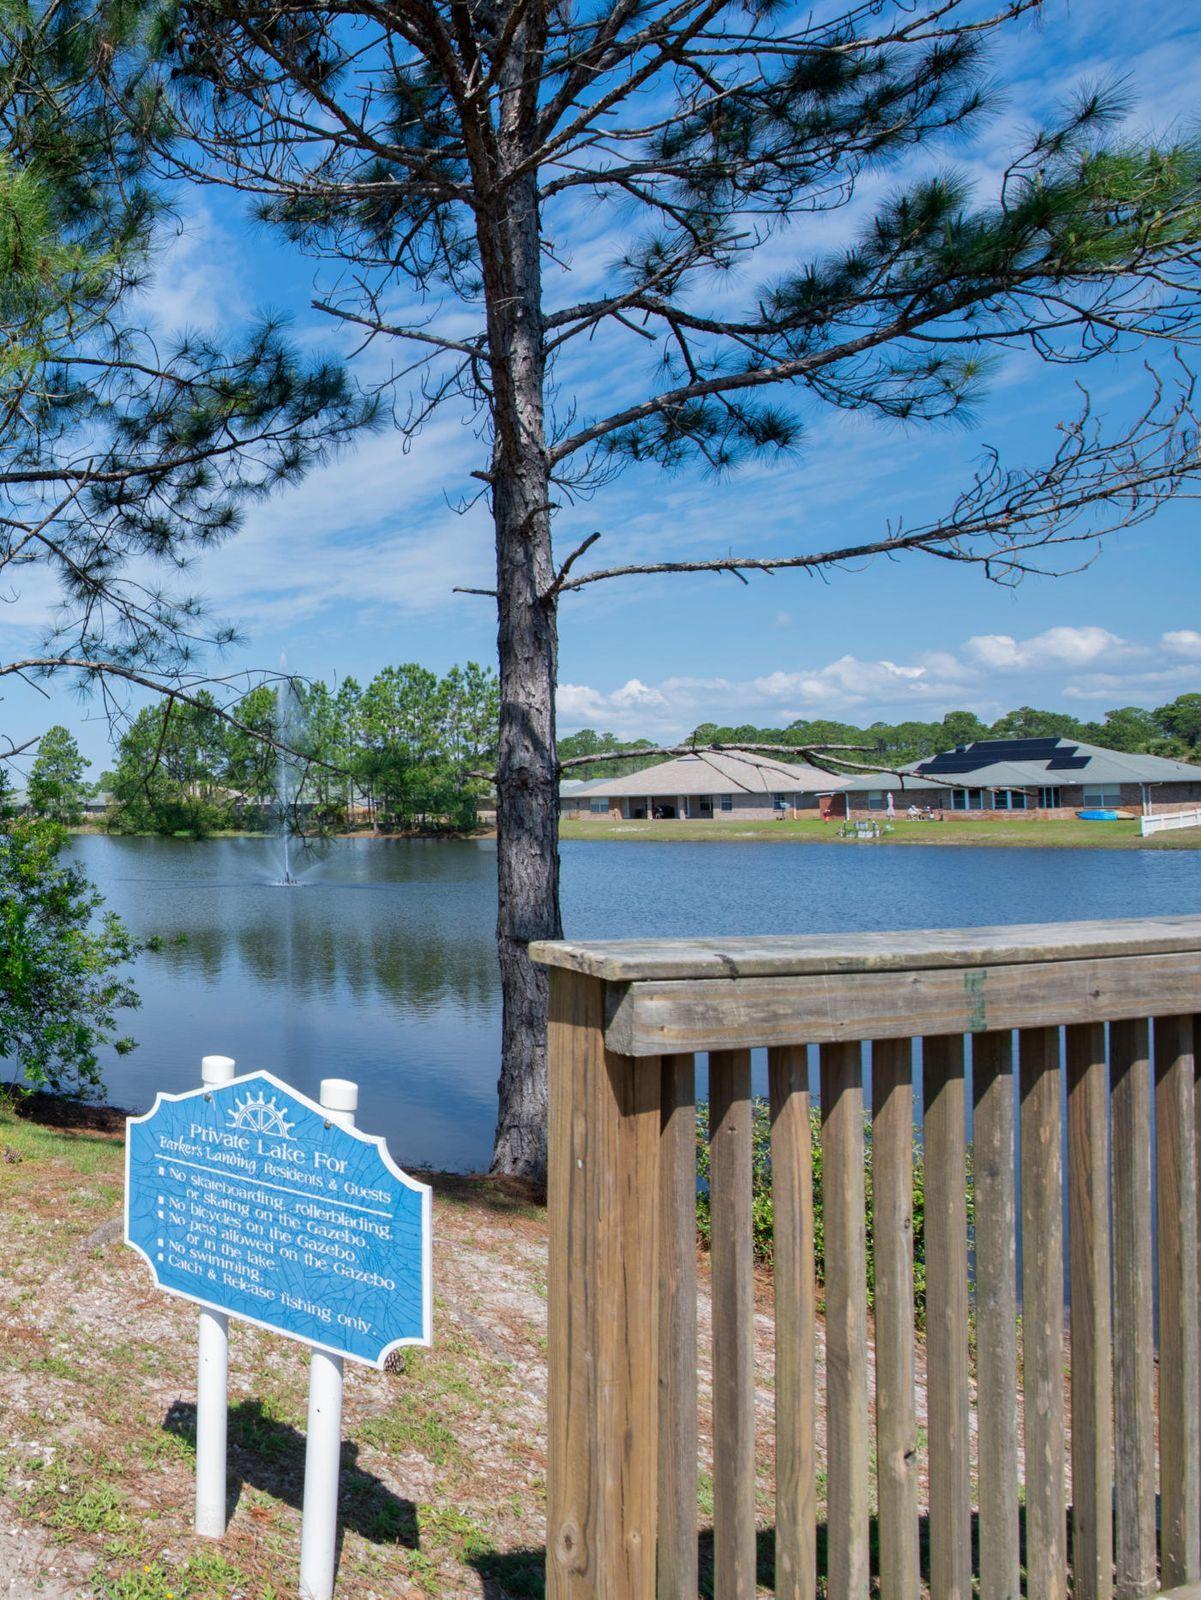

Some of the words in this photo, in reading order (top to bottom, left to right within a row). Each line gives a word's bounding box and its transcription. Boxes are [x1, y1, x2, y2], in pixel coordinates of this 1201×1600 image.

[190, 1123, 250, 1151] Private
[257, 1139, 305, 1164] Lake
[314, 1151, 348, 1173] For
[170, 1167, 187, 1182] No
[206, 1146, 256, 1175] Landing
[264, 1162, 323, 1188] Residents
[328, 1178, 338, 1191] &
[344, 1181, 392, 1204] Guests
[169, 1197, 186, 1211] No
[190, 1202, 241, 1228] bicycles
[246, 1222, 264, 1236] on
[270, 1227, 292, 1243] the
[186, 1188, 200, 1201] or
[203, 1193, 249, 1218] skating
[255, 1208, 273, 1222] on
[279, 1213, 301, 1229] the
[307, 1221, 370, 1250] Gazebo.
[169, 1212, 186, 1226] No
[190, 1220, 217, 1236] pets
[222, 1229, 274, 1255] allowed
[280, 1247, 298, 1261] on
[305, 1252, 327, 1270] the
[333, 1262, 395, 1291] Gazebo
[169, 1239, 186, 1254] No
[190, 1248, 264, 1283] swimming.
[186, 1233, 200, 1246] or
[204, 1238, 216, 1252] in
[221, 1243, 242, 1258] the
[247, 1250, 279, 1272] lake.
[168, 1254, 203, 1275] Catch
[208, 1268, 218, 1281] &
[223, 1272, 276, 1300] Release
[280, 1291, 332, 1323] fishing
[337, 1313, 377, 1336] only.
